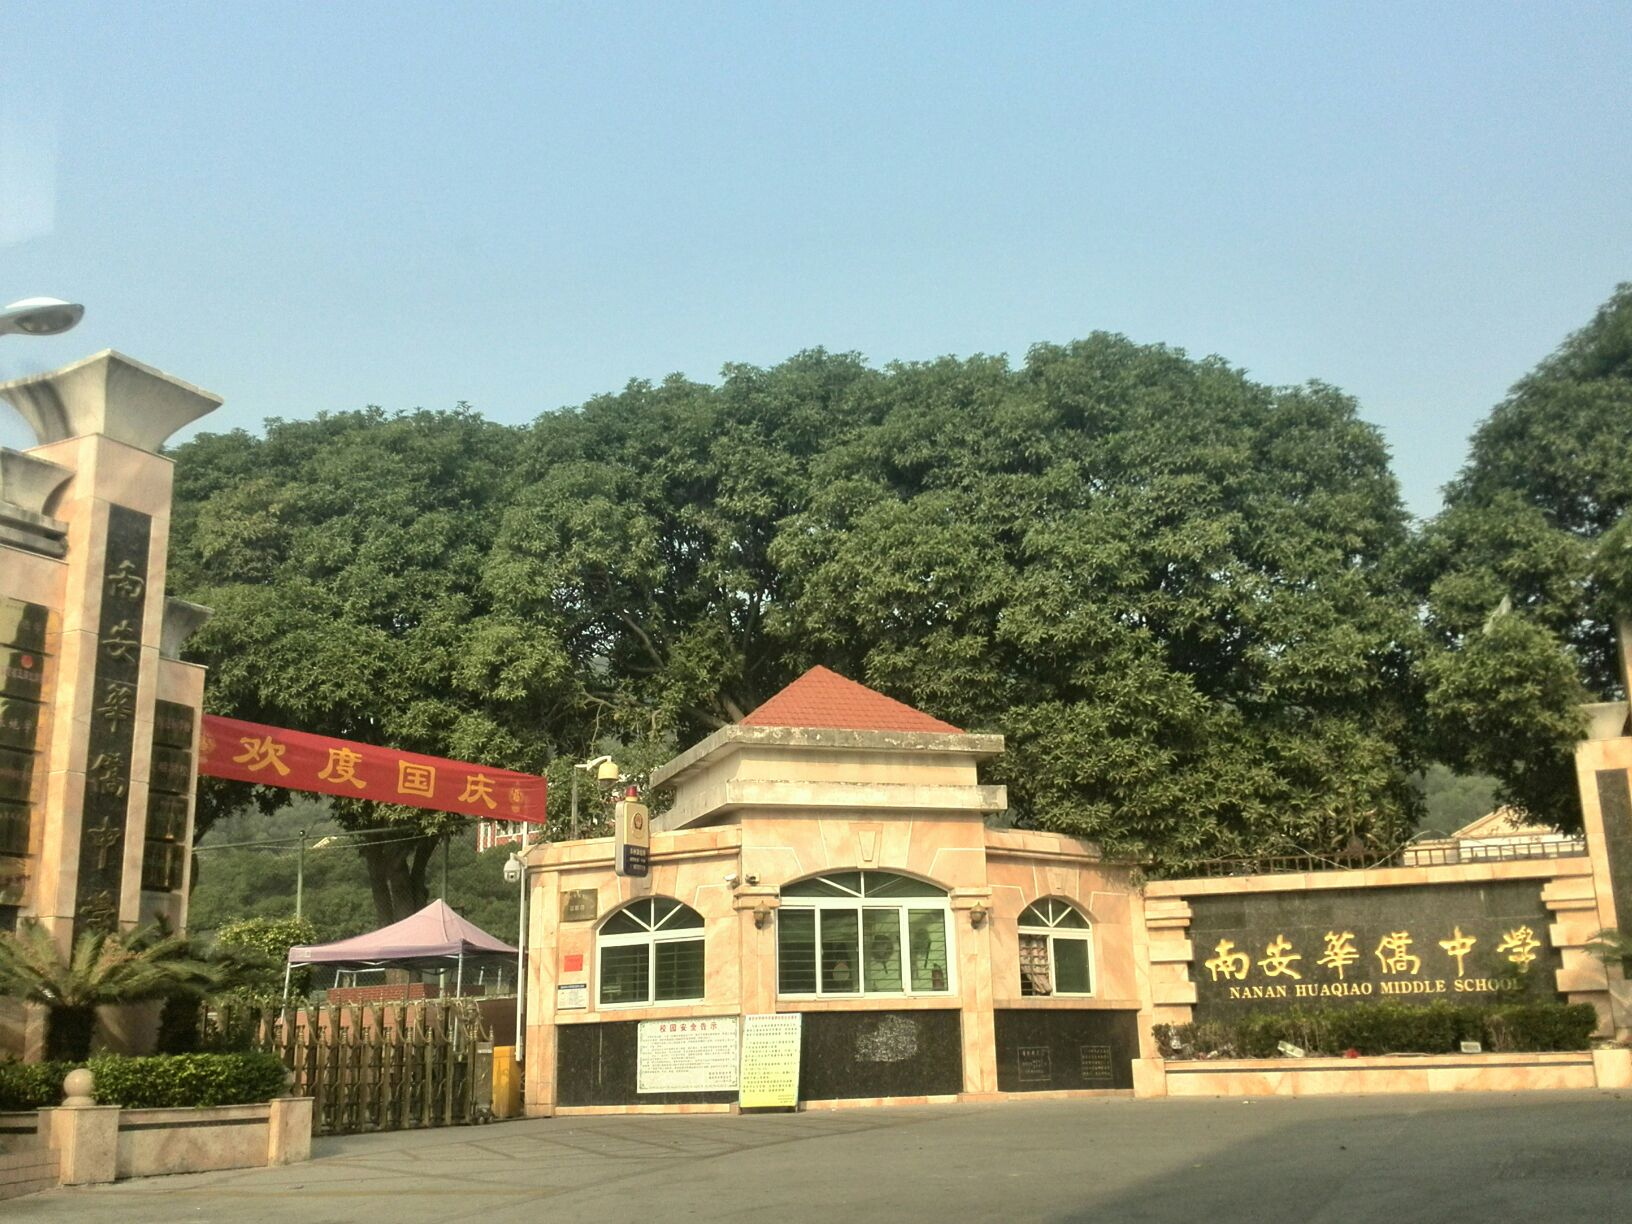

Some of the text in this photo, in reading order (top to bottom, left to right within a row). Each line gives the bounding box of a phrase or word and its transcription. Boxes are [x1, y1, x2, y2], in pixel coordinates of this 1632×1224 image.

[232, 735, 497, 810] 欢度国庆
[1204, 924, 1541, 982] 南安華僑中學
[1230, 977, 1524, 999] NANAN HUAQIAO MIDDLE SCHOOL
